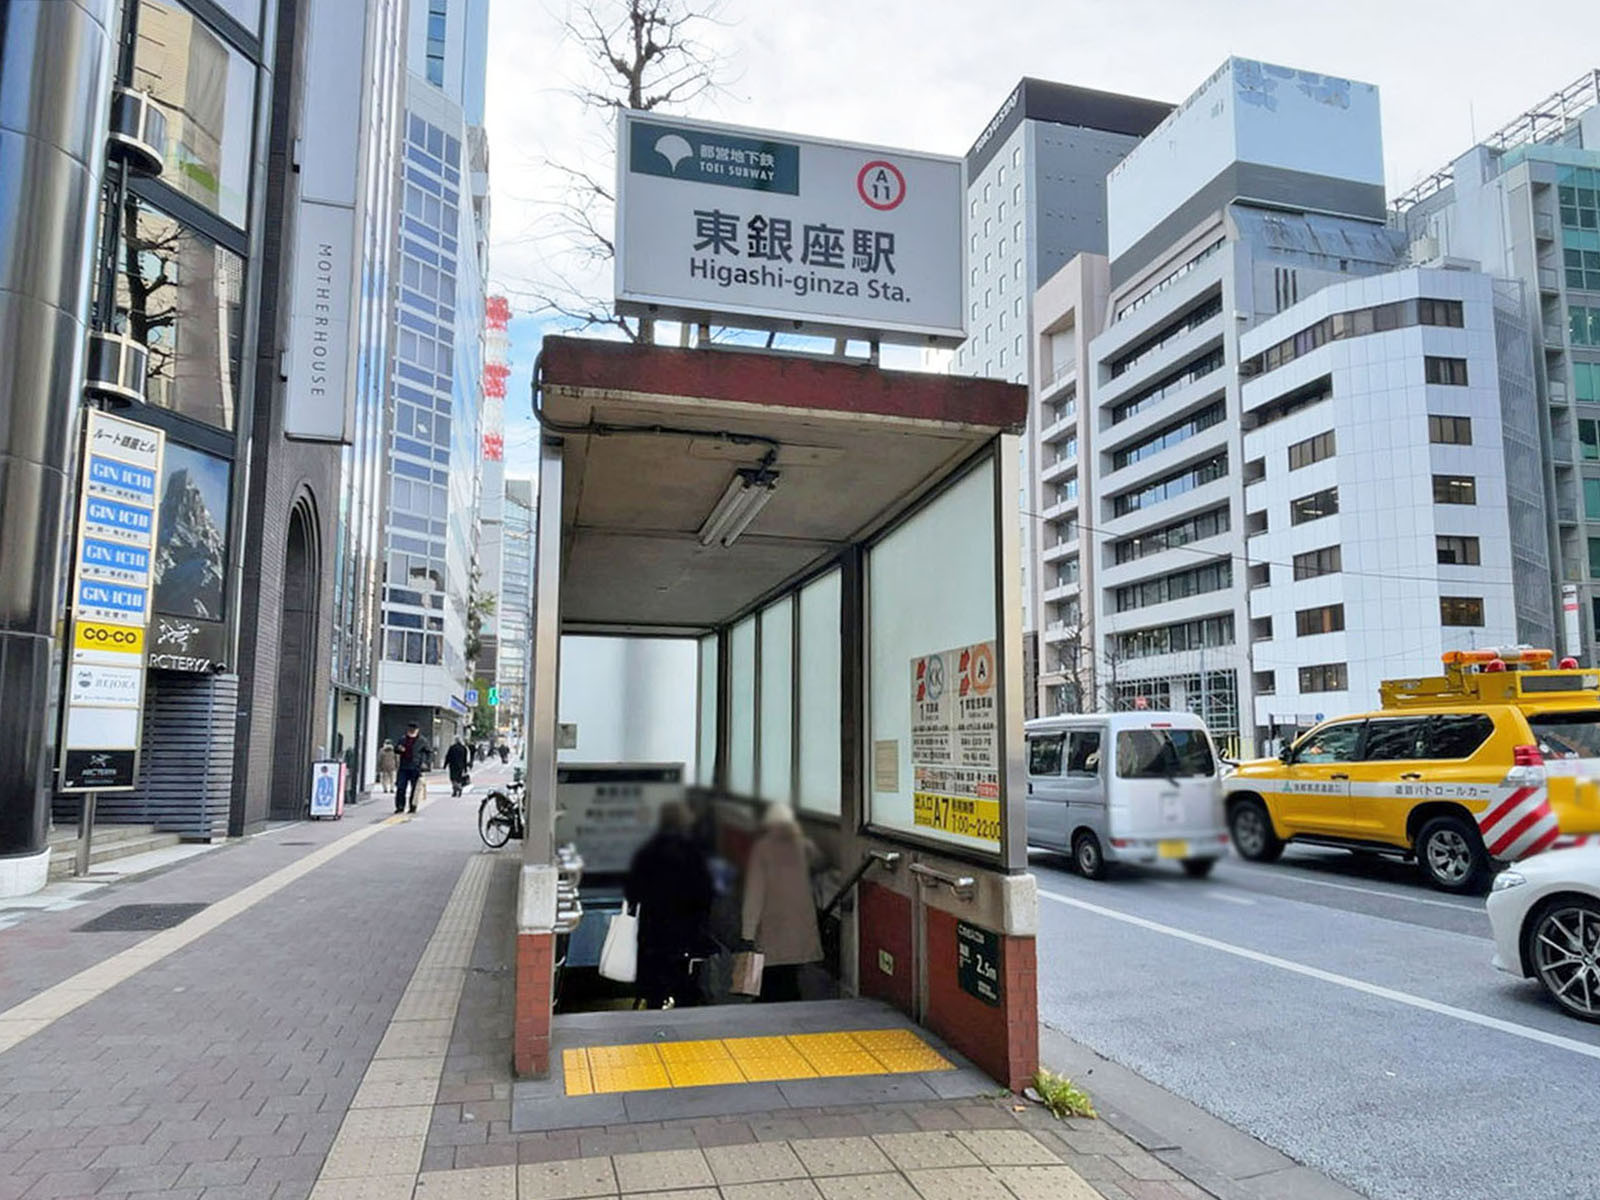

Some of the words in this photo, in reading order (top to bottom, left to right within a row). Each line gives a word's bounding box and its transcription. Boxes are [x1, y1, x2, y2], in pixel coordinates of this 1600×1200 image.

[700, 144, 775, 168] 都営地下鉄
[700, 161, 724, 174] TOEI
[728, 165, 774, 181] SUBWAY
[876, 169, 888, 183] A
[871, 184, 891, 201] 11
[693, 208, 896, 275] 東銀座駅
[689, 257, 859, 297] Higashi-ginza
[867, 277, 911, 303] Sta.
[310, 243, 333, 397] MOTHERHOUSE
[93, 462, 119, 481] GIN
[122, 469, 152, 489] ICHI
[89, 503, 115, 521] GIN
[118, 509, 149, 528] ICHI
[86, 544, 111, 562] GIN
[115, 549, 146, 568] ICHI
[82, 586, 109, 603] GIN
[112, 590, 143, 608] ICHI
[83, 627, 137, 644] CO-CO
[977, 660, 986, 679] A
[933, 797, 949, 830] A7
